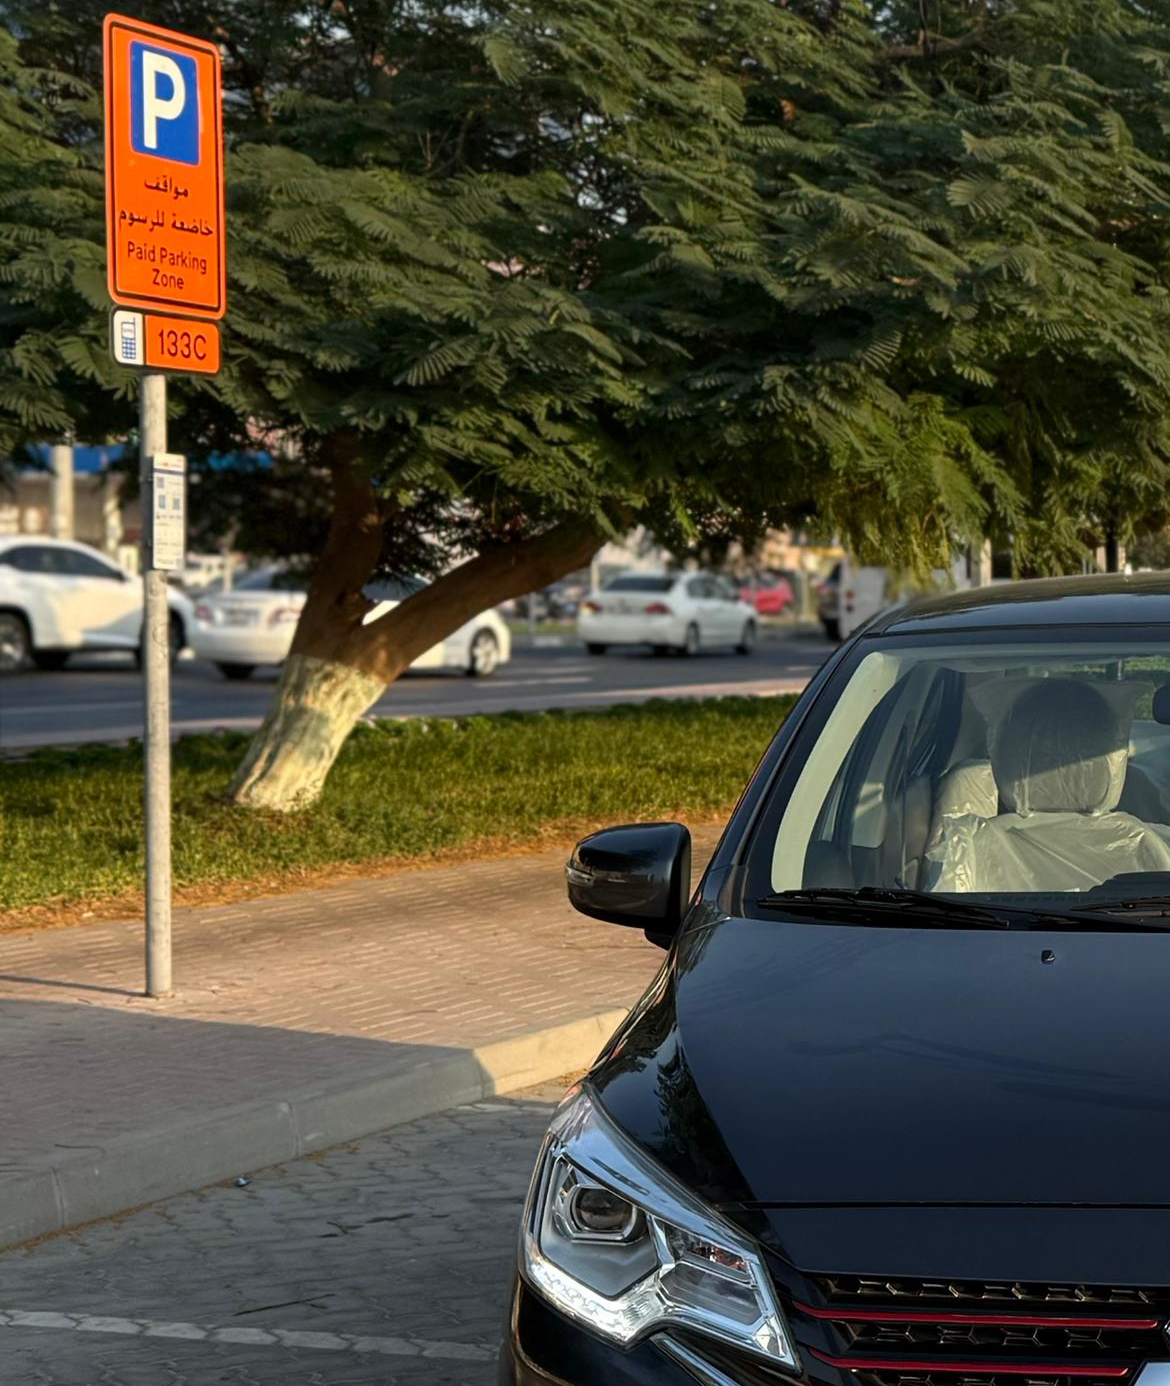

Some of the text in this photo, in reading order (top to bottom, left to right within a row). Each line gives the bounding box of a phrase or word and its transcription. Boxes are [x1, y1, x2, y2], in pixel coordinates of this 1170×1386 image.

[142, 50, 186, 149] P
[144, 175, 189, 200] مواقف
[119, 210, 214, 237] خاضعة للرسوم
[127, 241, 207, 274] Paid Parking
[152, 268, 184, 289] Zone
[158, 329, 207, 360] 133C
